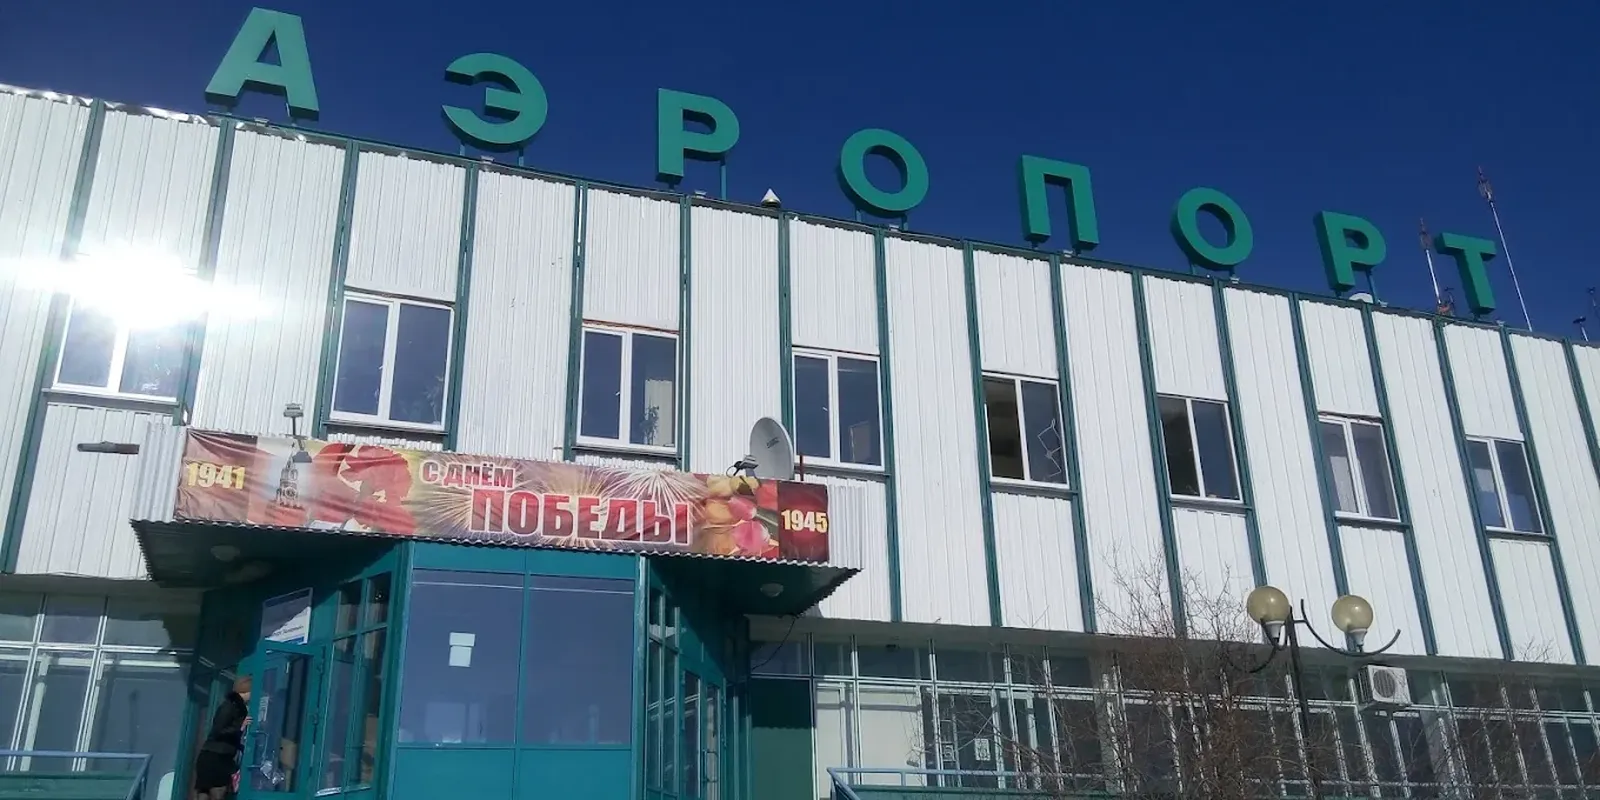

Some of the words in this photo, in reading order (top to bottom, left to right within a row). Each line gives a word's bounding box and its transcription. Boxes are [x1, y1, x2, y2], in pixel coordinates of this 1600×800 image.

[205, 7, 1498, 315] АЭРОПОРТ
[186, 462, 246, 490] 1941
[420, 460, 439, 483] С
[442, 461, 516, 488] ДНЁМ
[469, 487, 691, 545] ПОБЕДЫ
[781, 509, 828, 533] 1945
